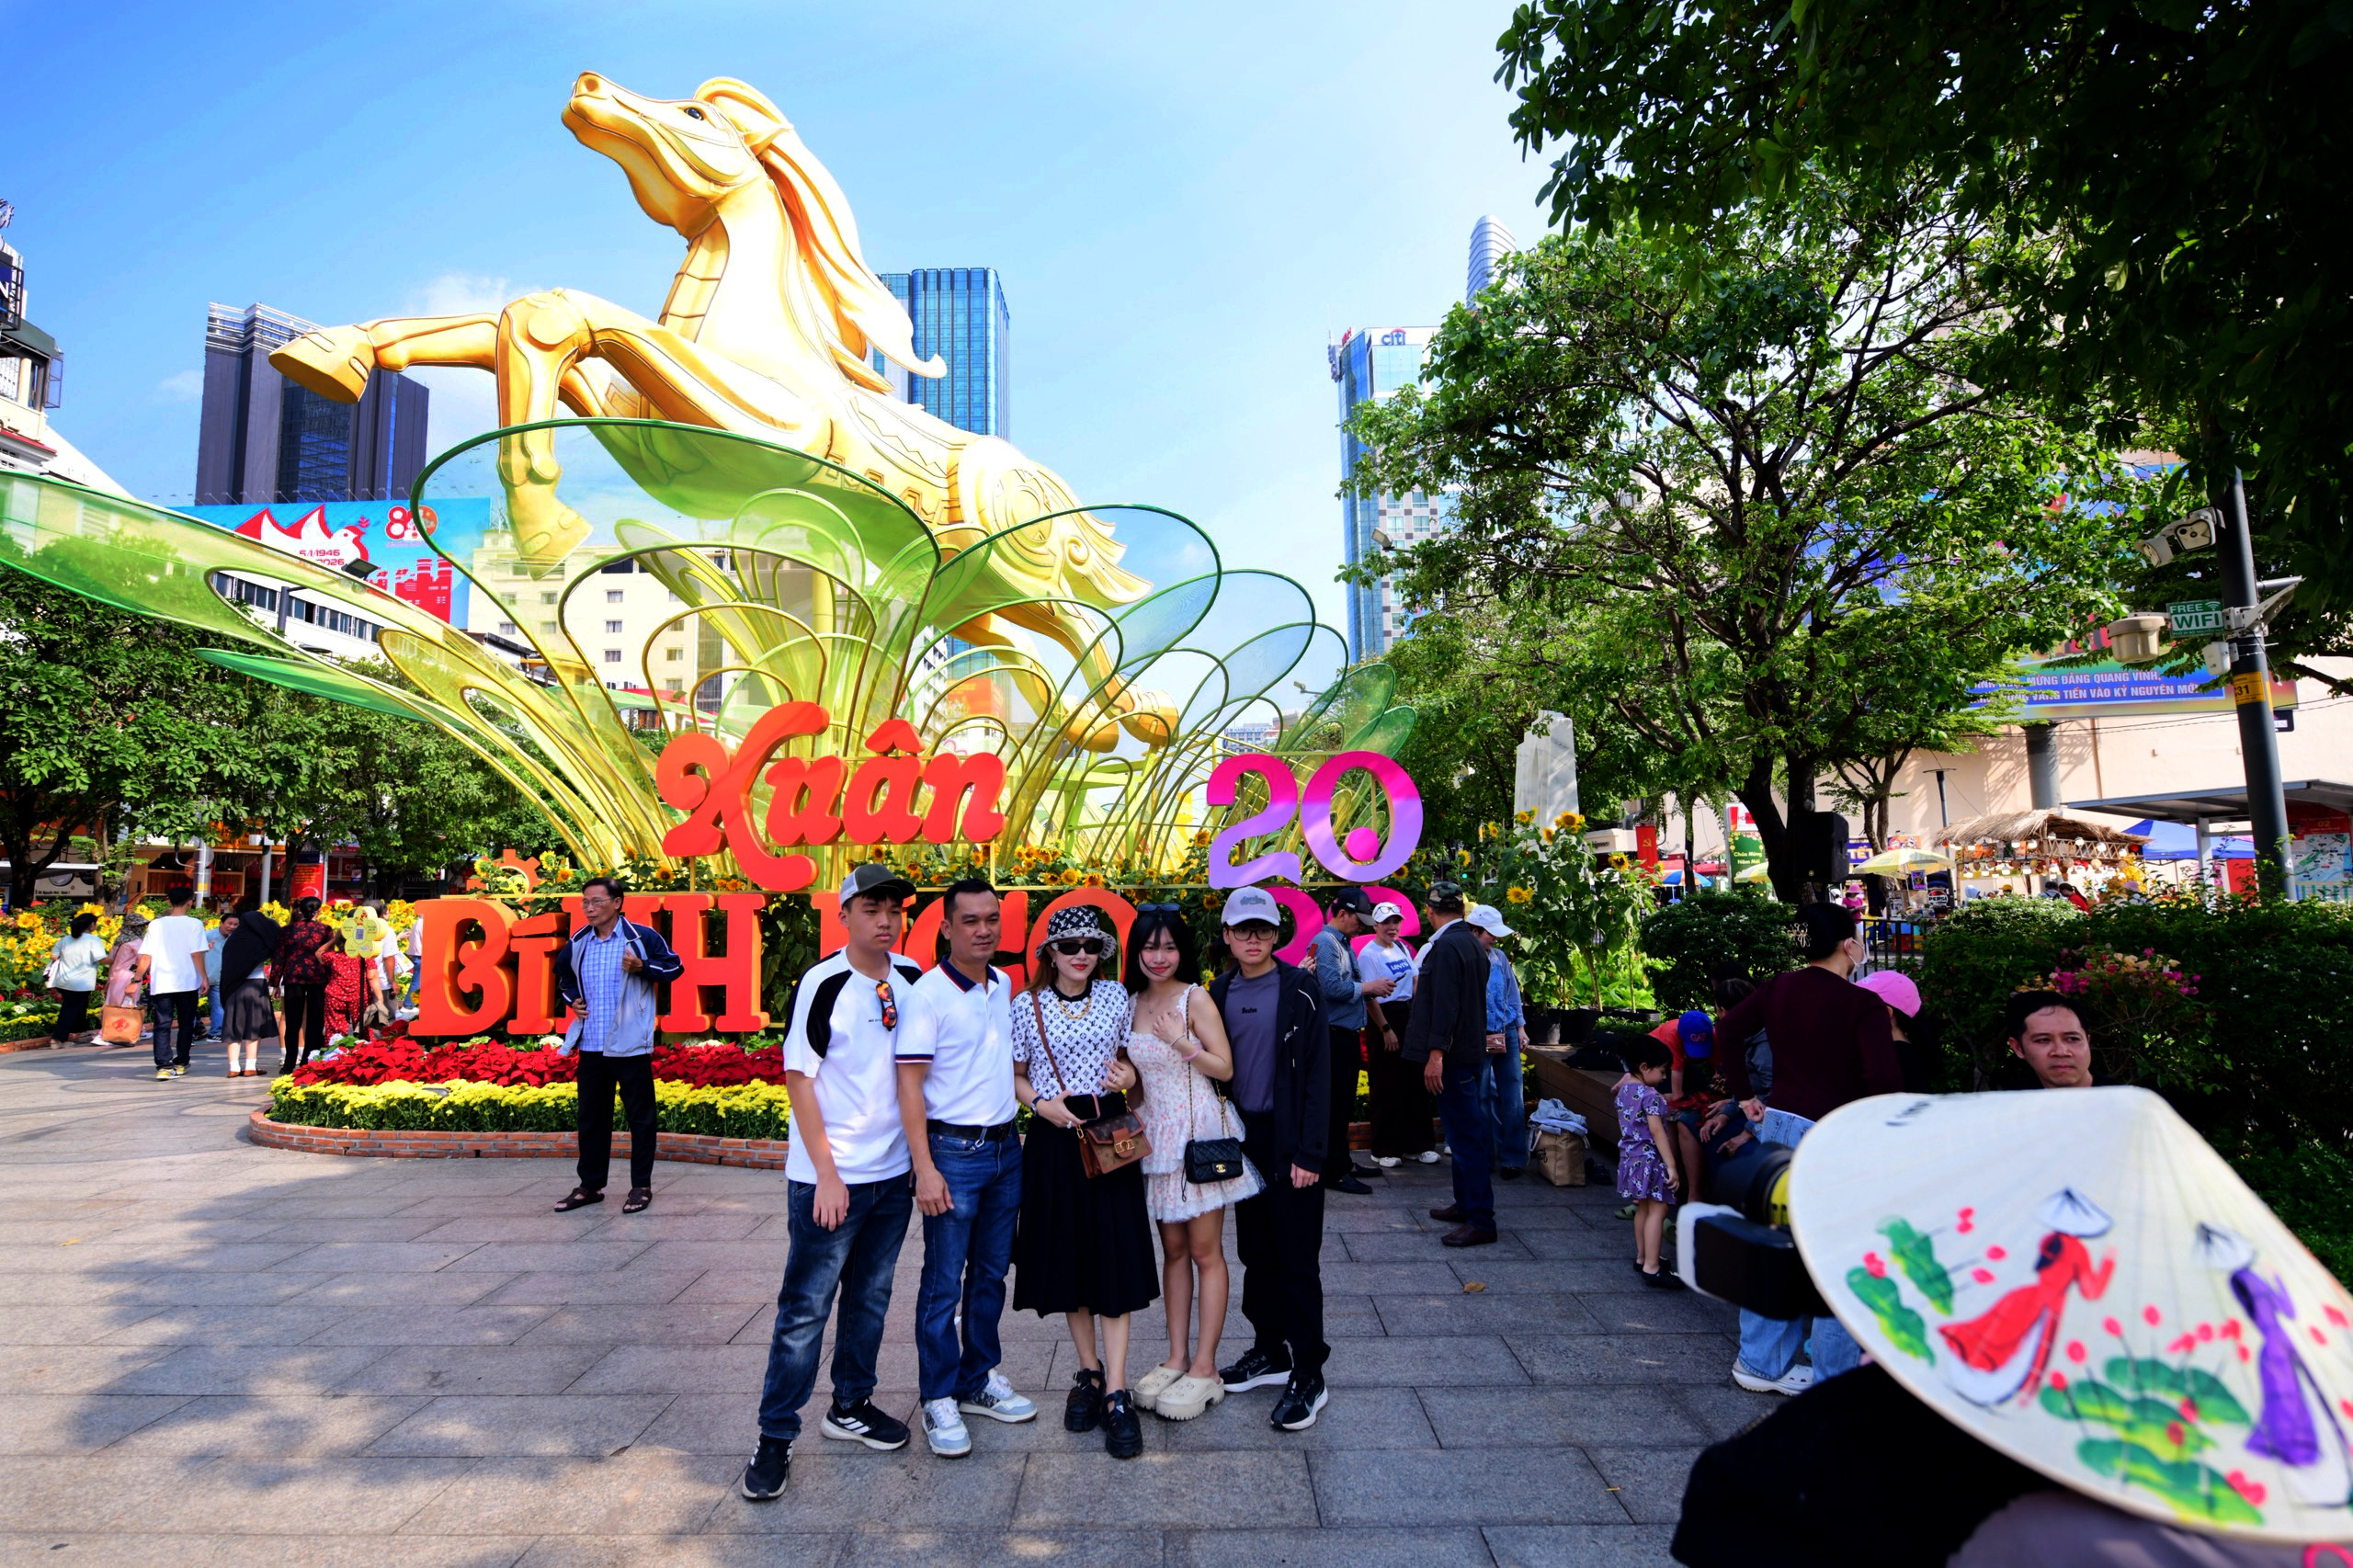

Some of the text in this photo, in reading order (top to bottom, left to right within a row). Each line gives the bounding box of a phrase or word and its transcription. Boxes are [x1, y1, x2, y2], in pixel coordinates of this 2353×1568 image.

[1381, 330, 1405, 346] citi
[2170, 603, 2204, 614] FREE
[2174, 613, 2220, 629] WIFI
[2062, 672, 2091, 685] ĐẢNG
[2094, 672, 2130, 684] QUANG
[2063, 687, 2087, 699] TIẾN
[2090, 687, 2111, 699] VÀO
[2114, 684, 2128, 697] KỶ
[2131, 684, 2175, 696] NGUYÊN
[656, 701, 1007, 891] Xuân
[1207, 750, 1424, 890] 20
[1847, 845, 1874, 859] TẾT
[409, 892, 771, 1036] BÍH
